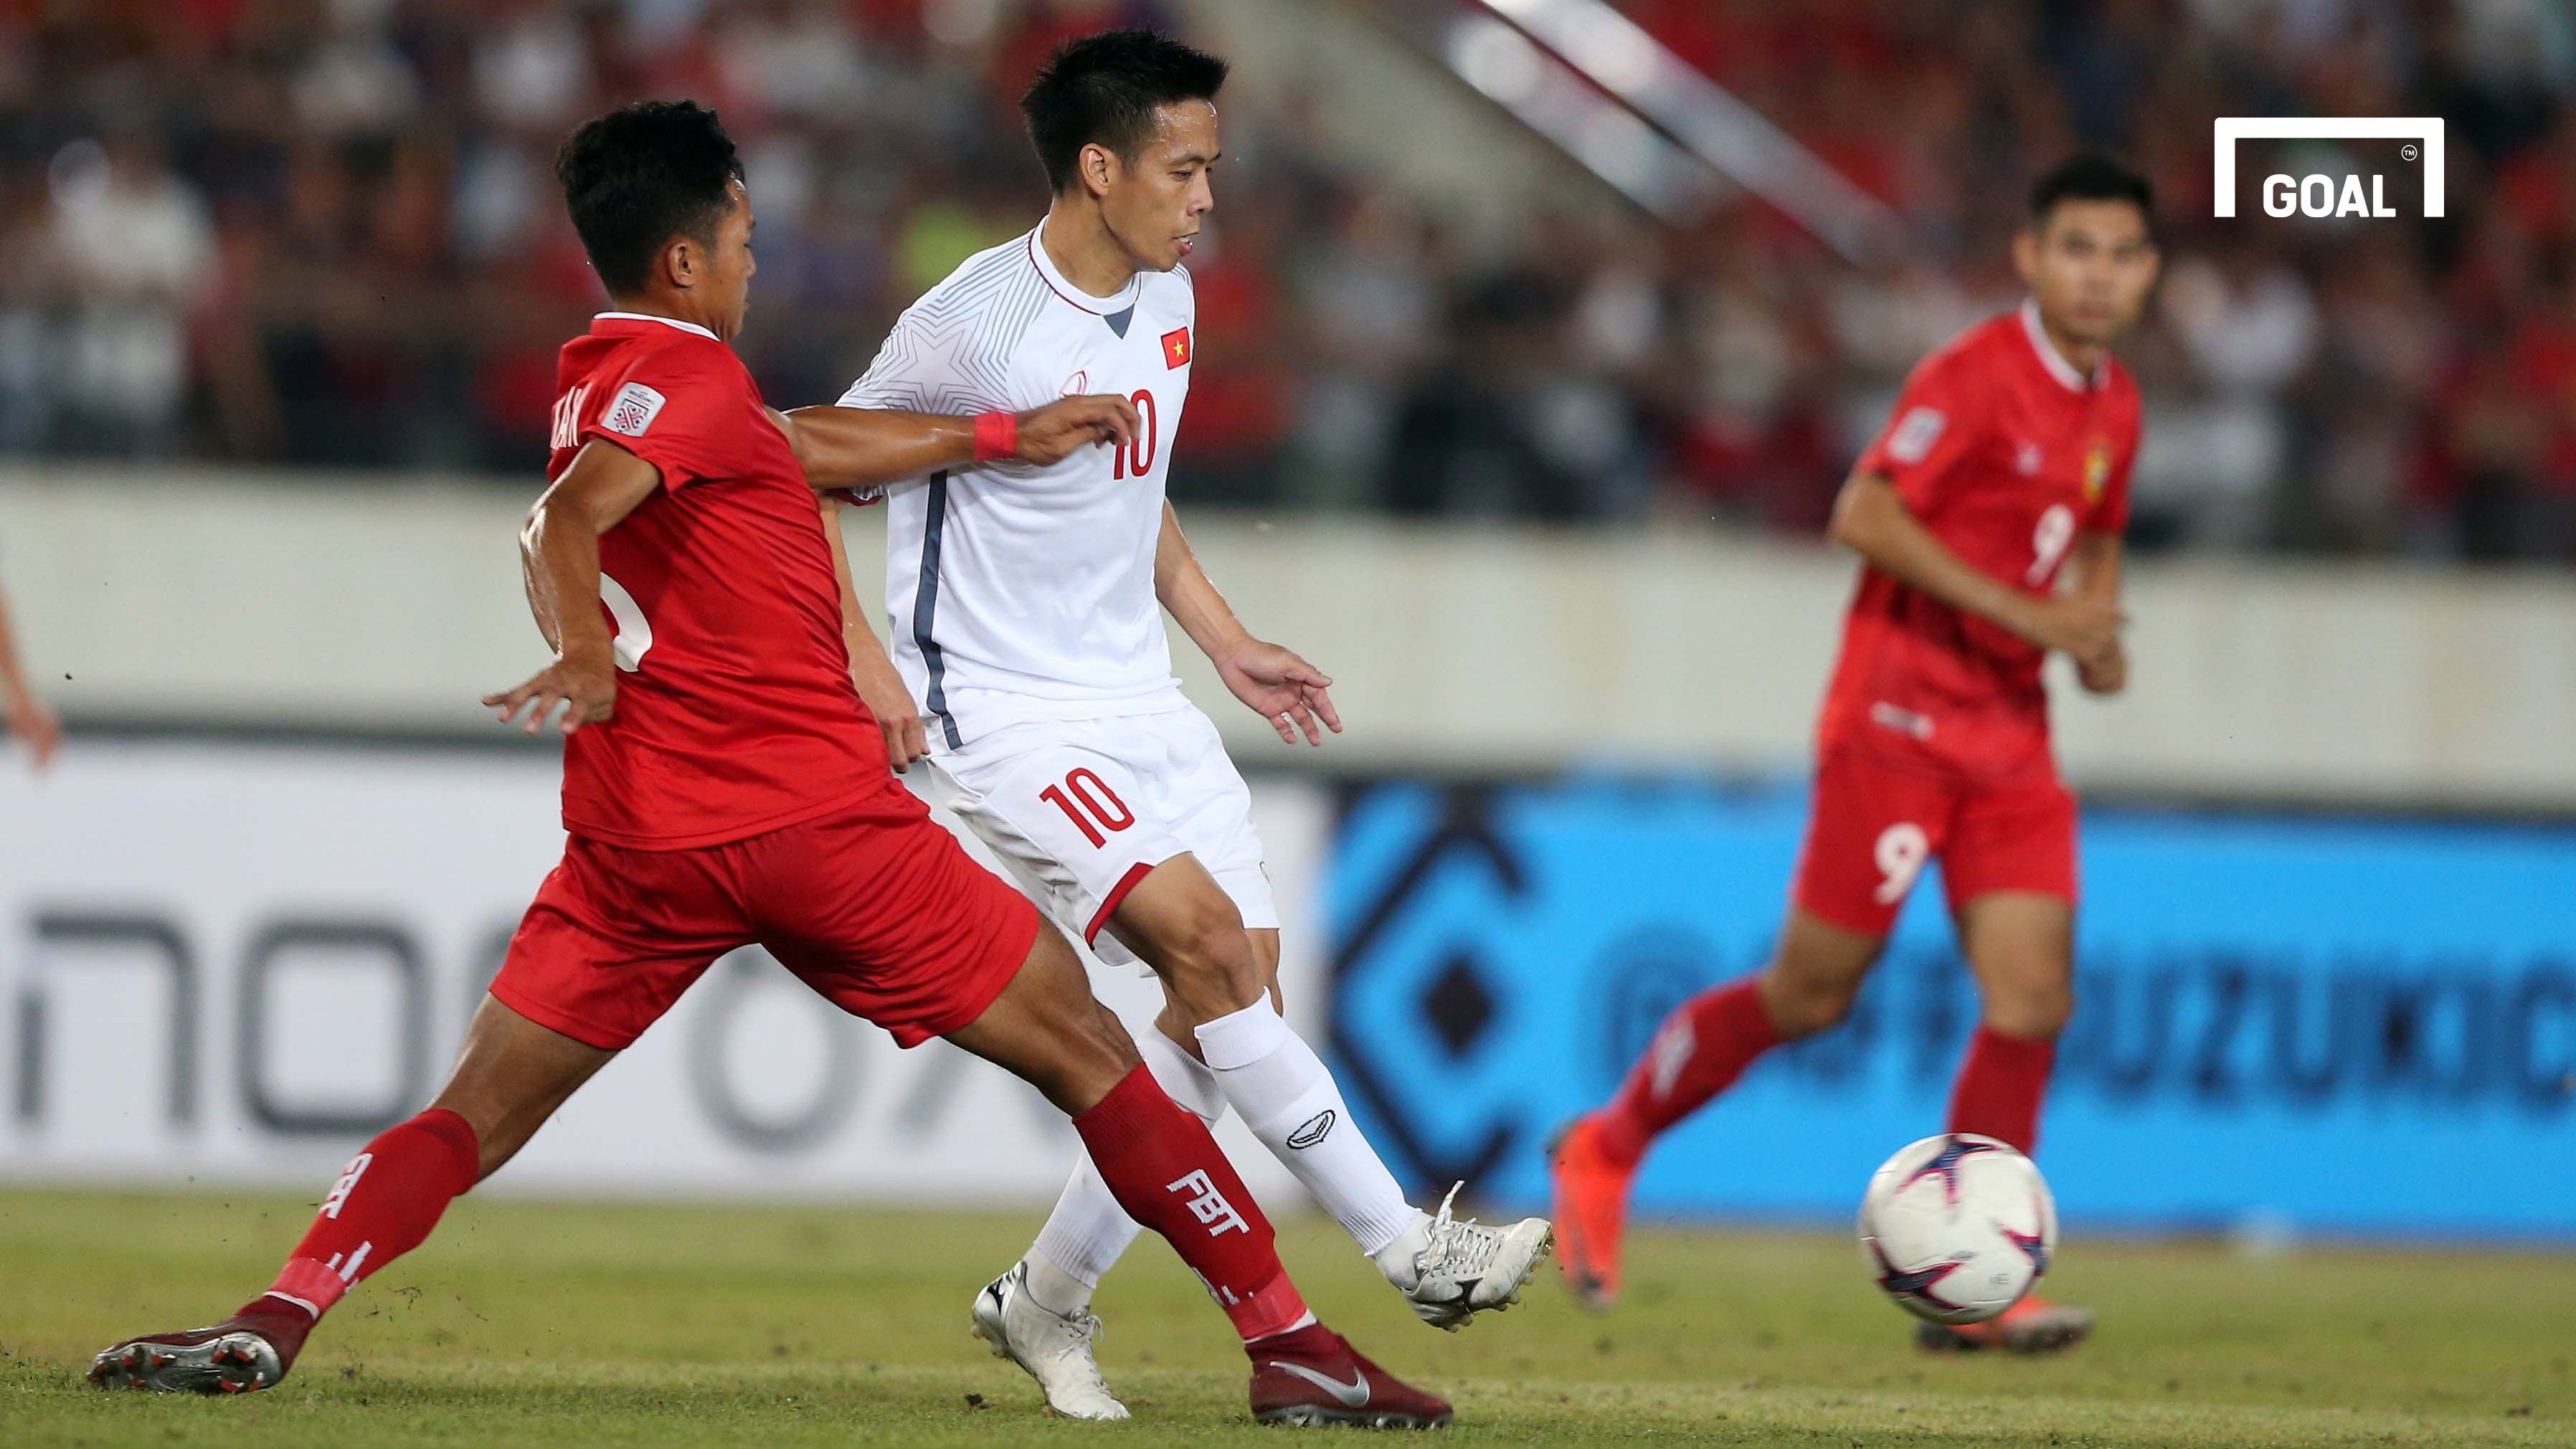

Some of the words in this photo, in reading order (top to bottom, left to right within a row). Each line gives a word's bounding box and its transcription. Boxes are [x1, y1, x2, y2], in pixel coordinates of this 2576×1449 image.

[2025, 503, 2075, 586] 9
[1039, 767, 1135, 849] 10
[1872, 822, 1929, 905] 9
[1166, 1168, 1250, 1237] FBT
